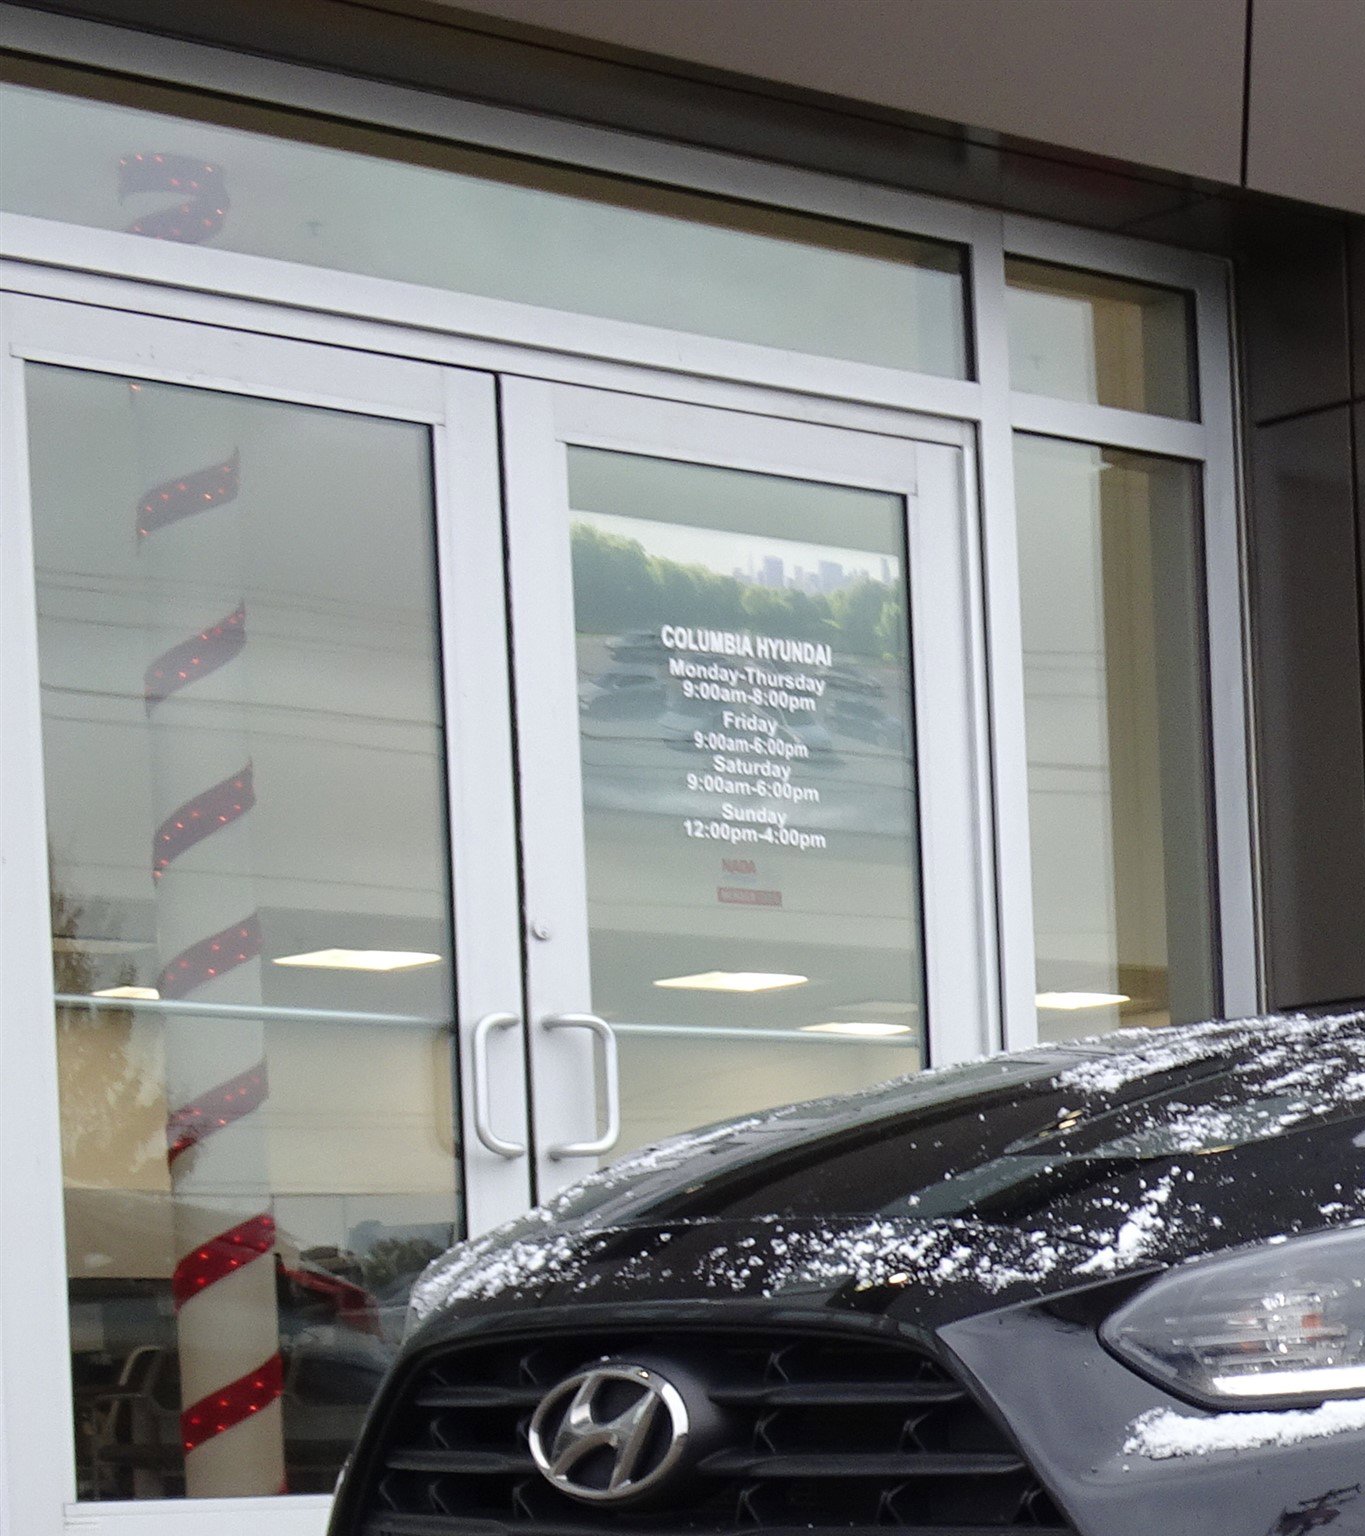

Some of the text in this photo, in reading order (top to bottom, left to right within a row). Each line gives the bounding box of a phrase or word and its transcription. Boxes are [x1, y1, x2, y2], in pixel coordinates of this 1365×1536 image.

[660, 624, 832, 667] COLUMBIA HYUNDAI
[669, 658, 826, 696] Monday-Thursday
[683, 680, 816, 712] 9:00am-8:00pm
[722, 711, 778, 737] Friday
[693, 731, 809, 760] 9:00am-6:00pm
[713, 754, 791, 781] Saturday
[686, 773, 820, 803] 9:00am-6:00pm
[721, 803, 788, 828] Sunday
[683, 820, 827, 851] 12:00pm-4:00pm
